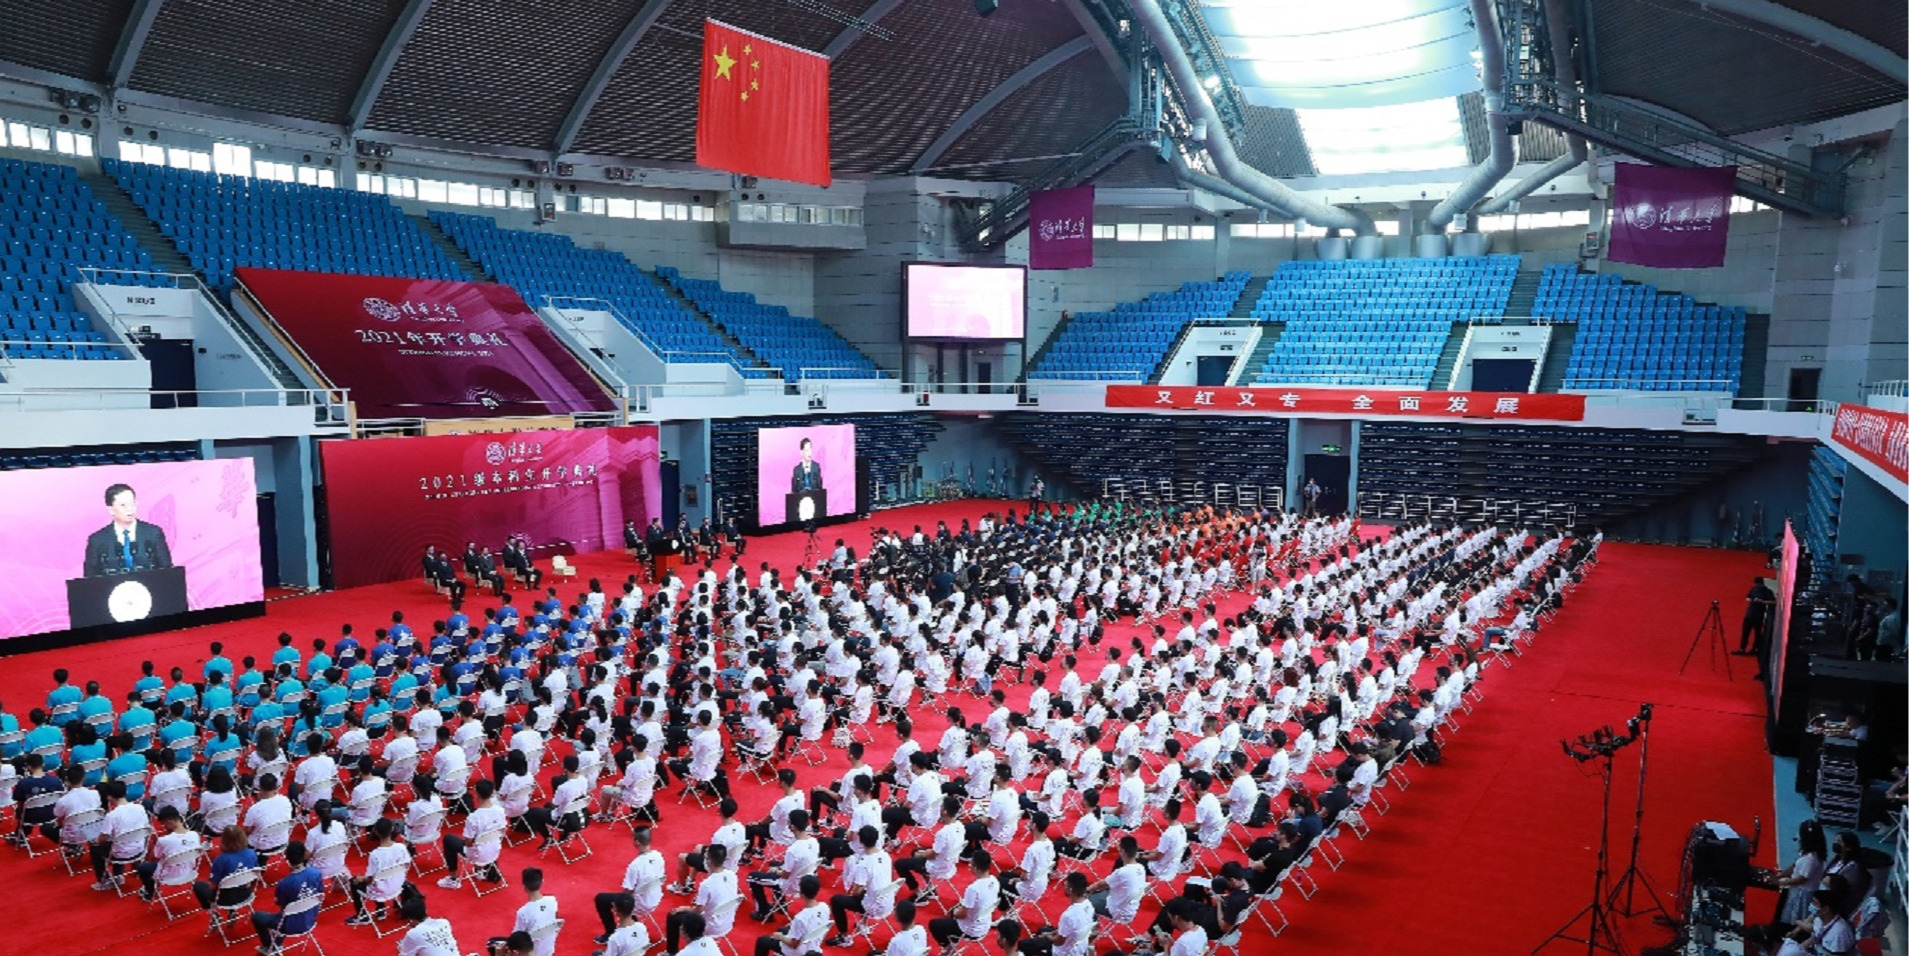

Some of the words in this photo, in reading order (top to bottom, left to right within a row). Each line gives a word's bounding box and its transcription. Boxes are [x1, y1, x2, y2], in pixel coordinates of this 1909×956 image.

[354, 329, 508, 346] 2021年开学典礼
[1155, 390, 1301, 408] 又红又专
[1352, 394, 1519, 414] 全面发展
[419, 464, 597, 490] 2021级本科生开学典礼
